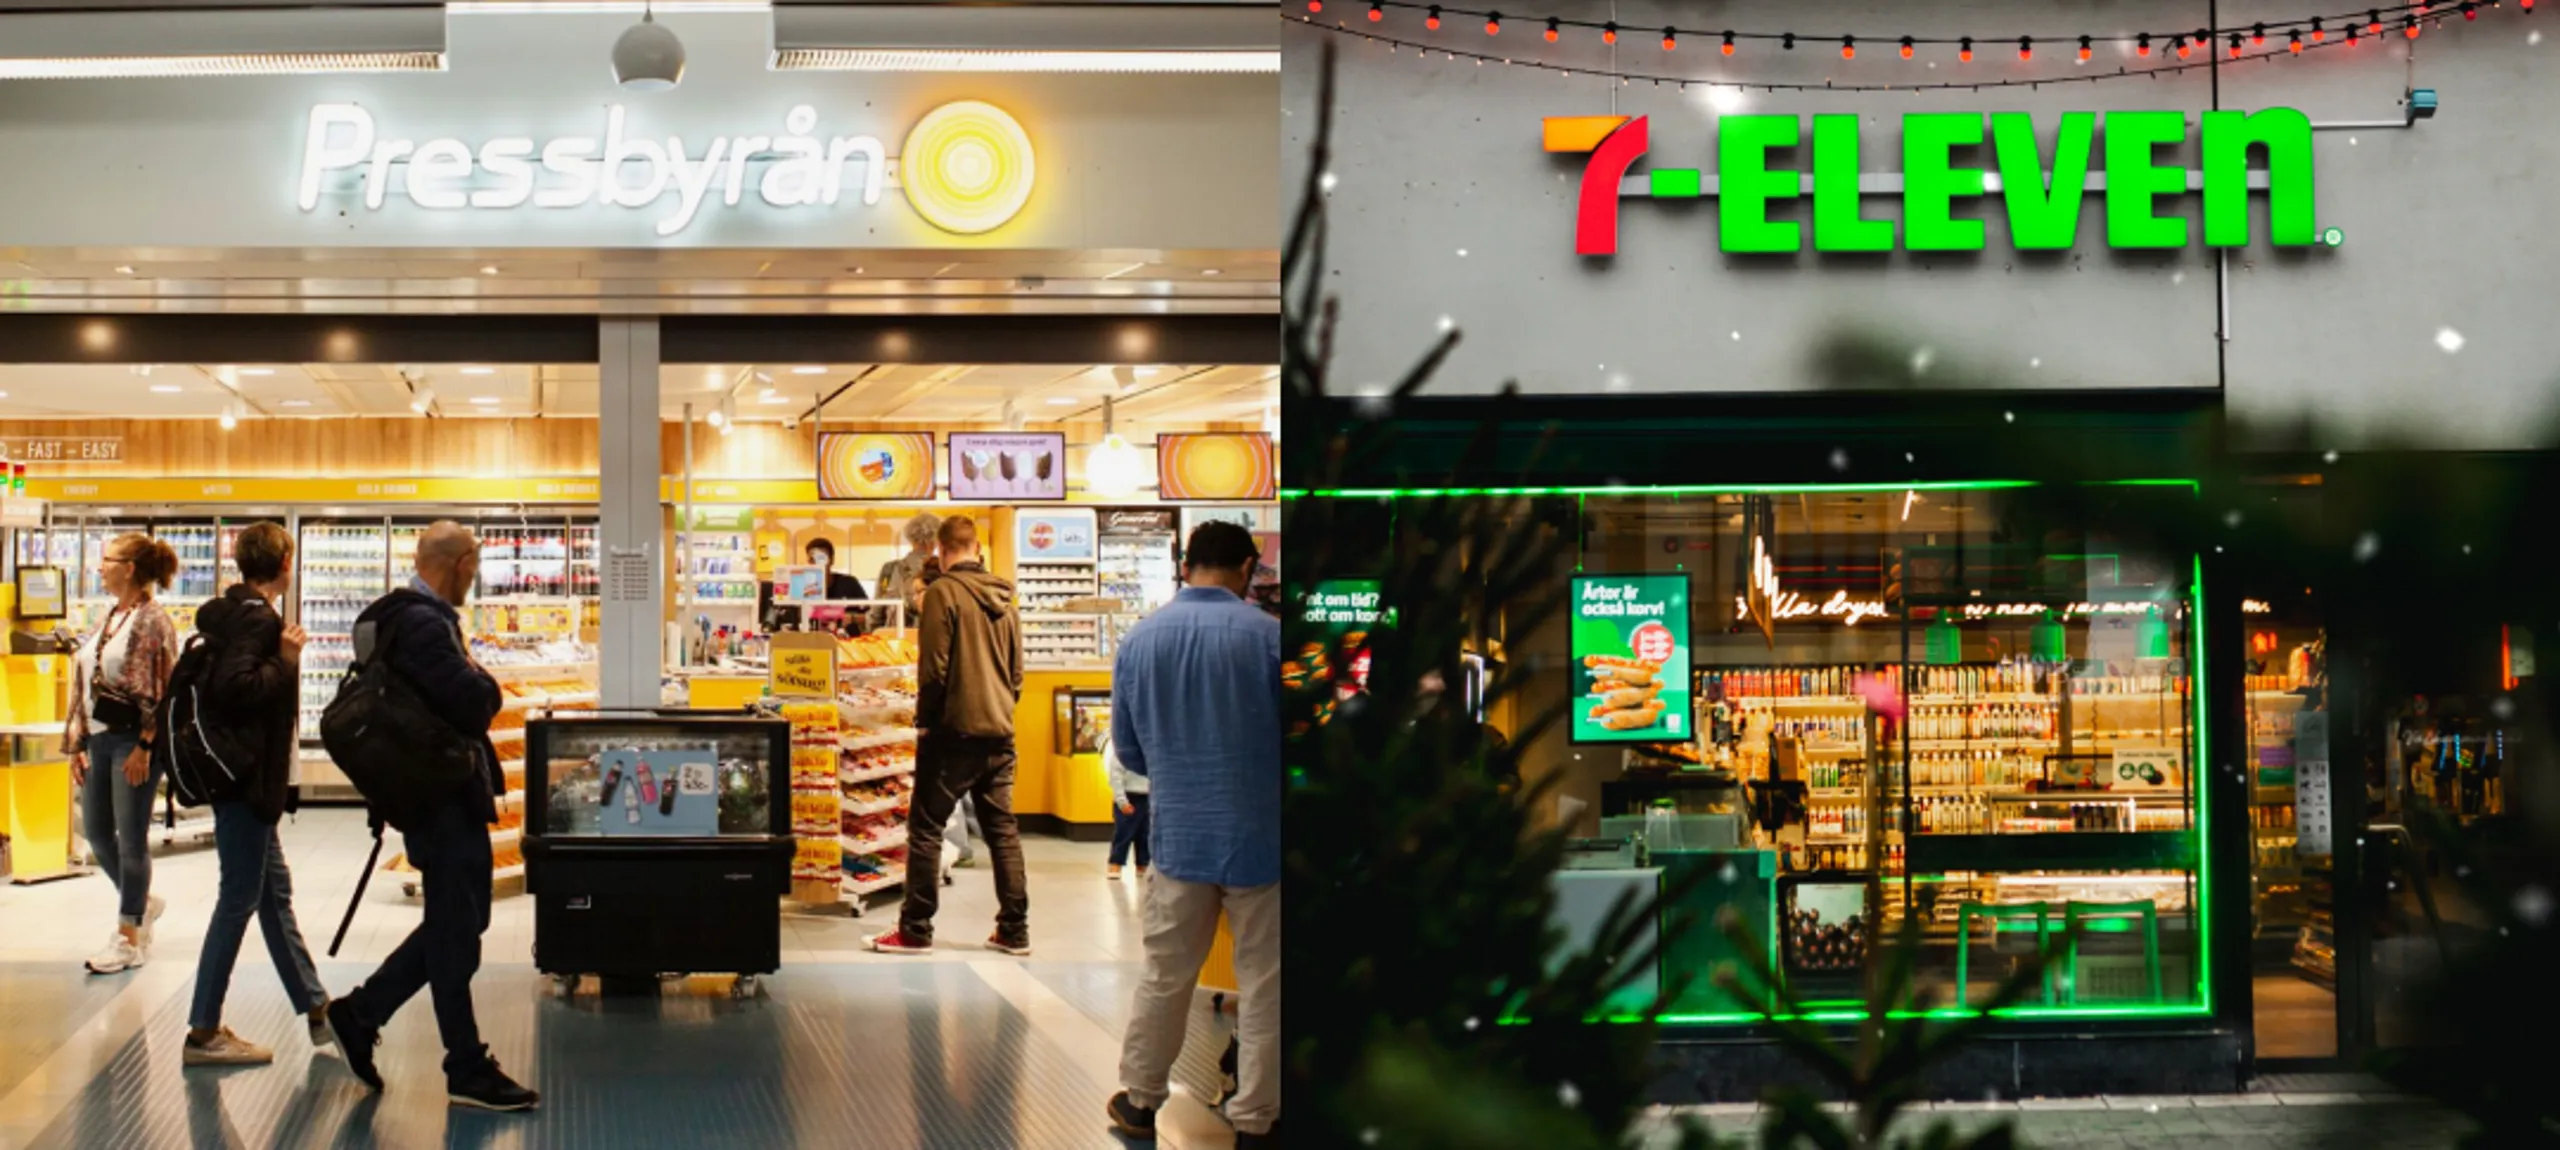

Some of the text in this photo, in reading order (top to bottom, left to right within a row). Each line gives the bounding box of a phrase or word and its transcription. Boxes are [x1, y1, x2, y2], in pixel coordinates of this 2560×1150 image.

[297, 102, 885, 236] Pressbyrån
[27, 441, 62, 459] FAST
[82, 441, 118, 459] EASY
[1325, 594, 1350, 607] om
[1351, 591, 1381, 608] tid?
[1328, 610, 1354, 622] om
